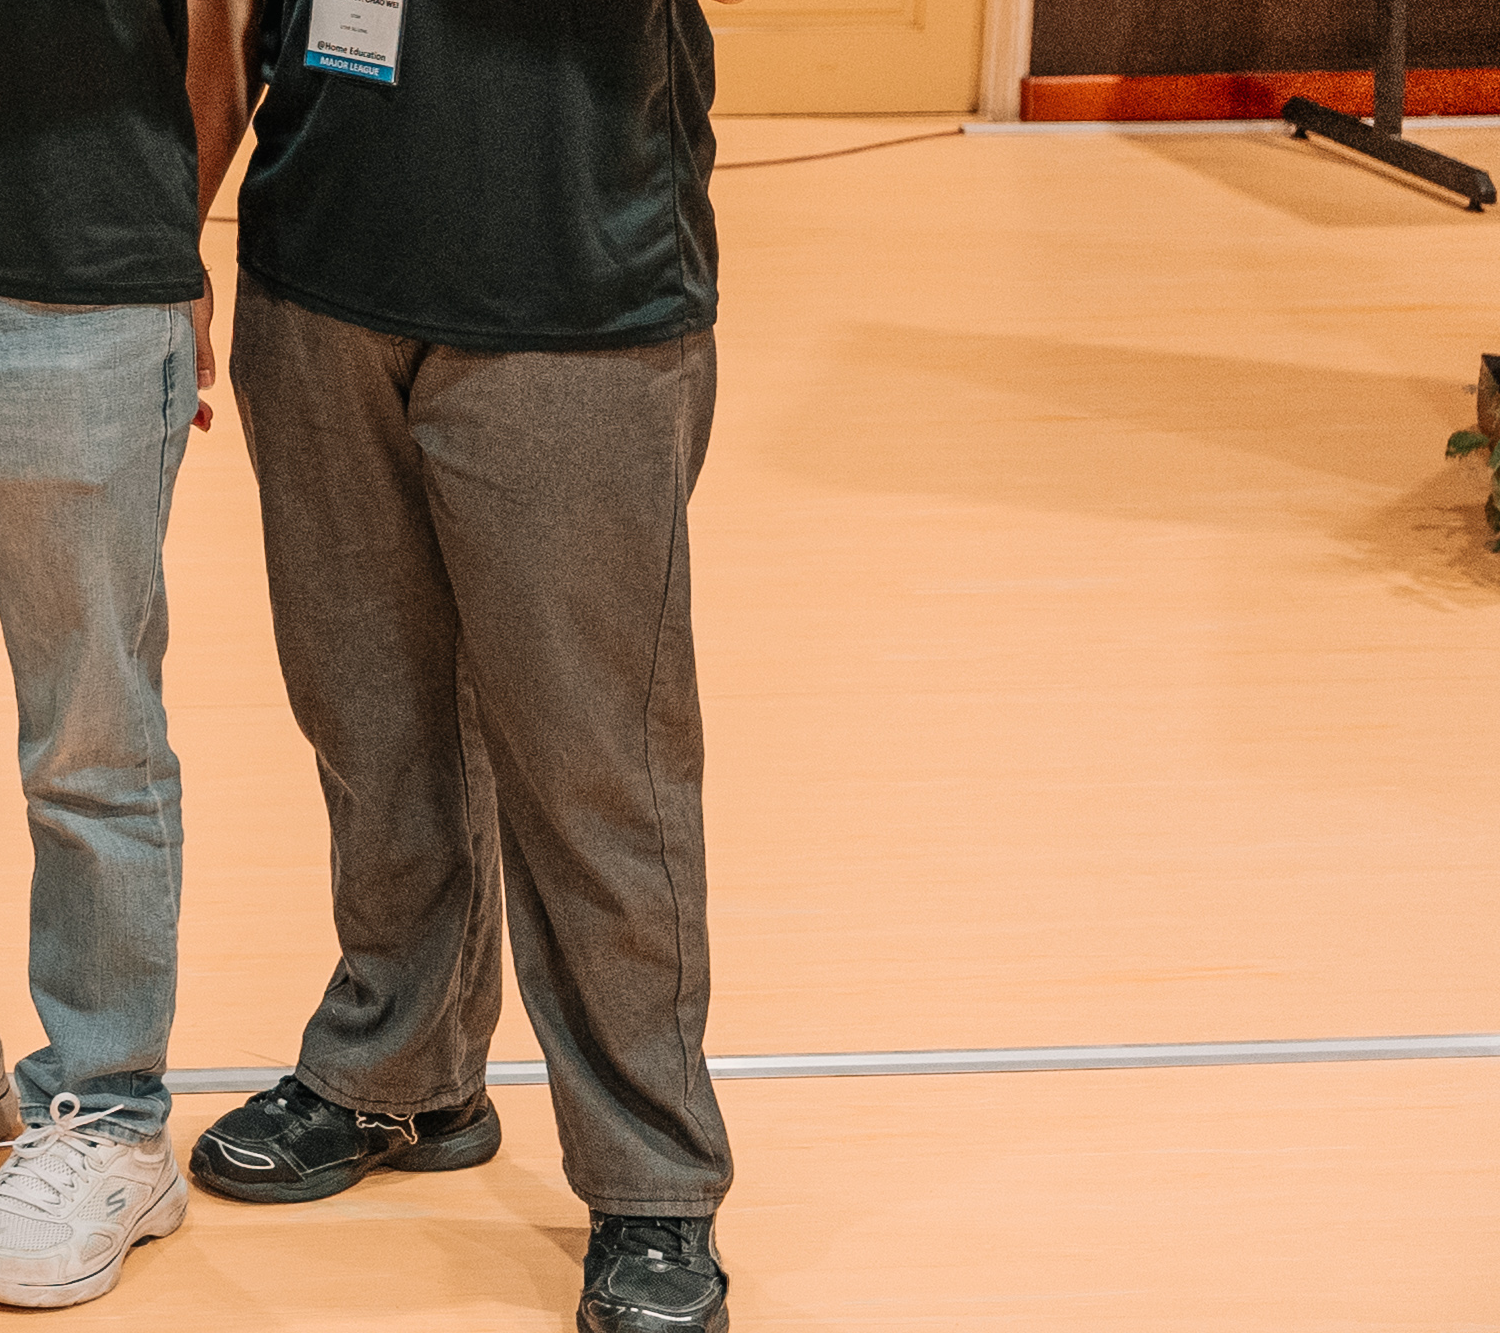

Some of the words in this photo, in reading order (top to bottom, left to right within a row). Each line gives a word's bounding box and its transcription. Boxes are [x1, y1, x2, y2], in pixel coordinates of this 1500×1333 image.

[317, 40, 347, 54] @Home
[349, 47, 386, 62] Education
[320, 56, 349, 69] MAJOR
[349, 62, 380, 76] LEAGUE
